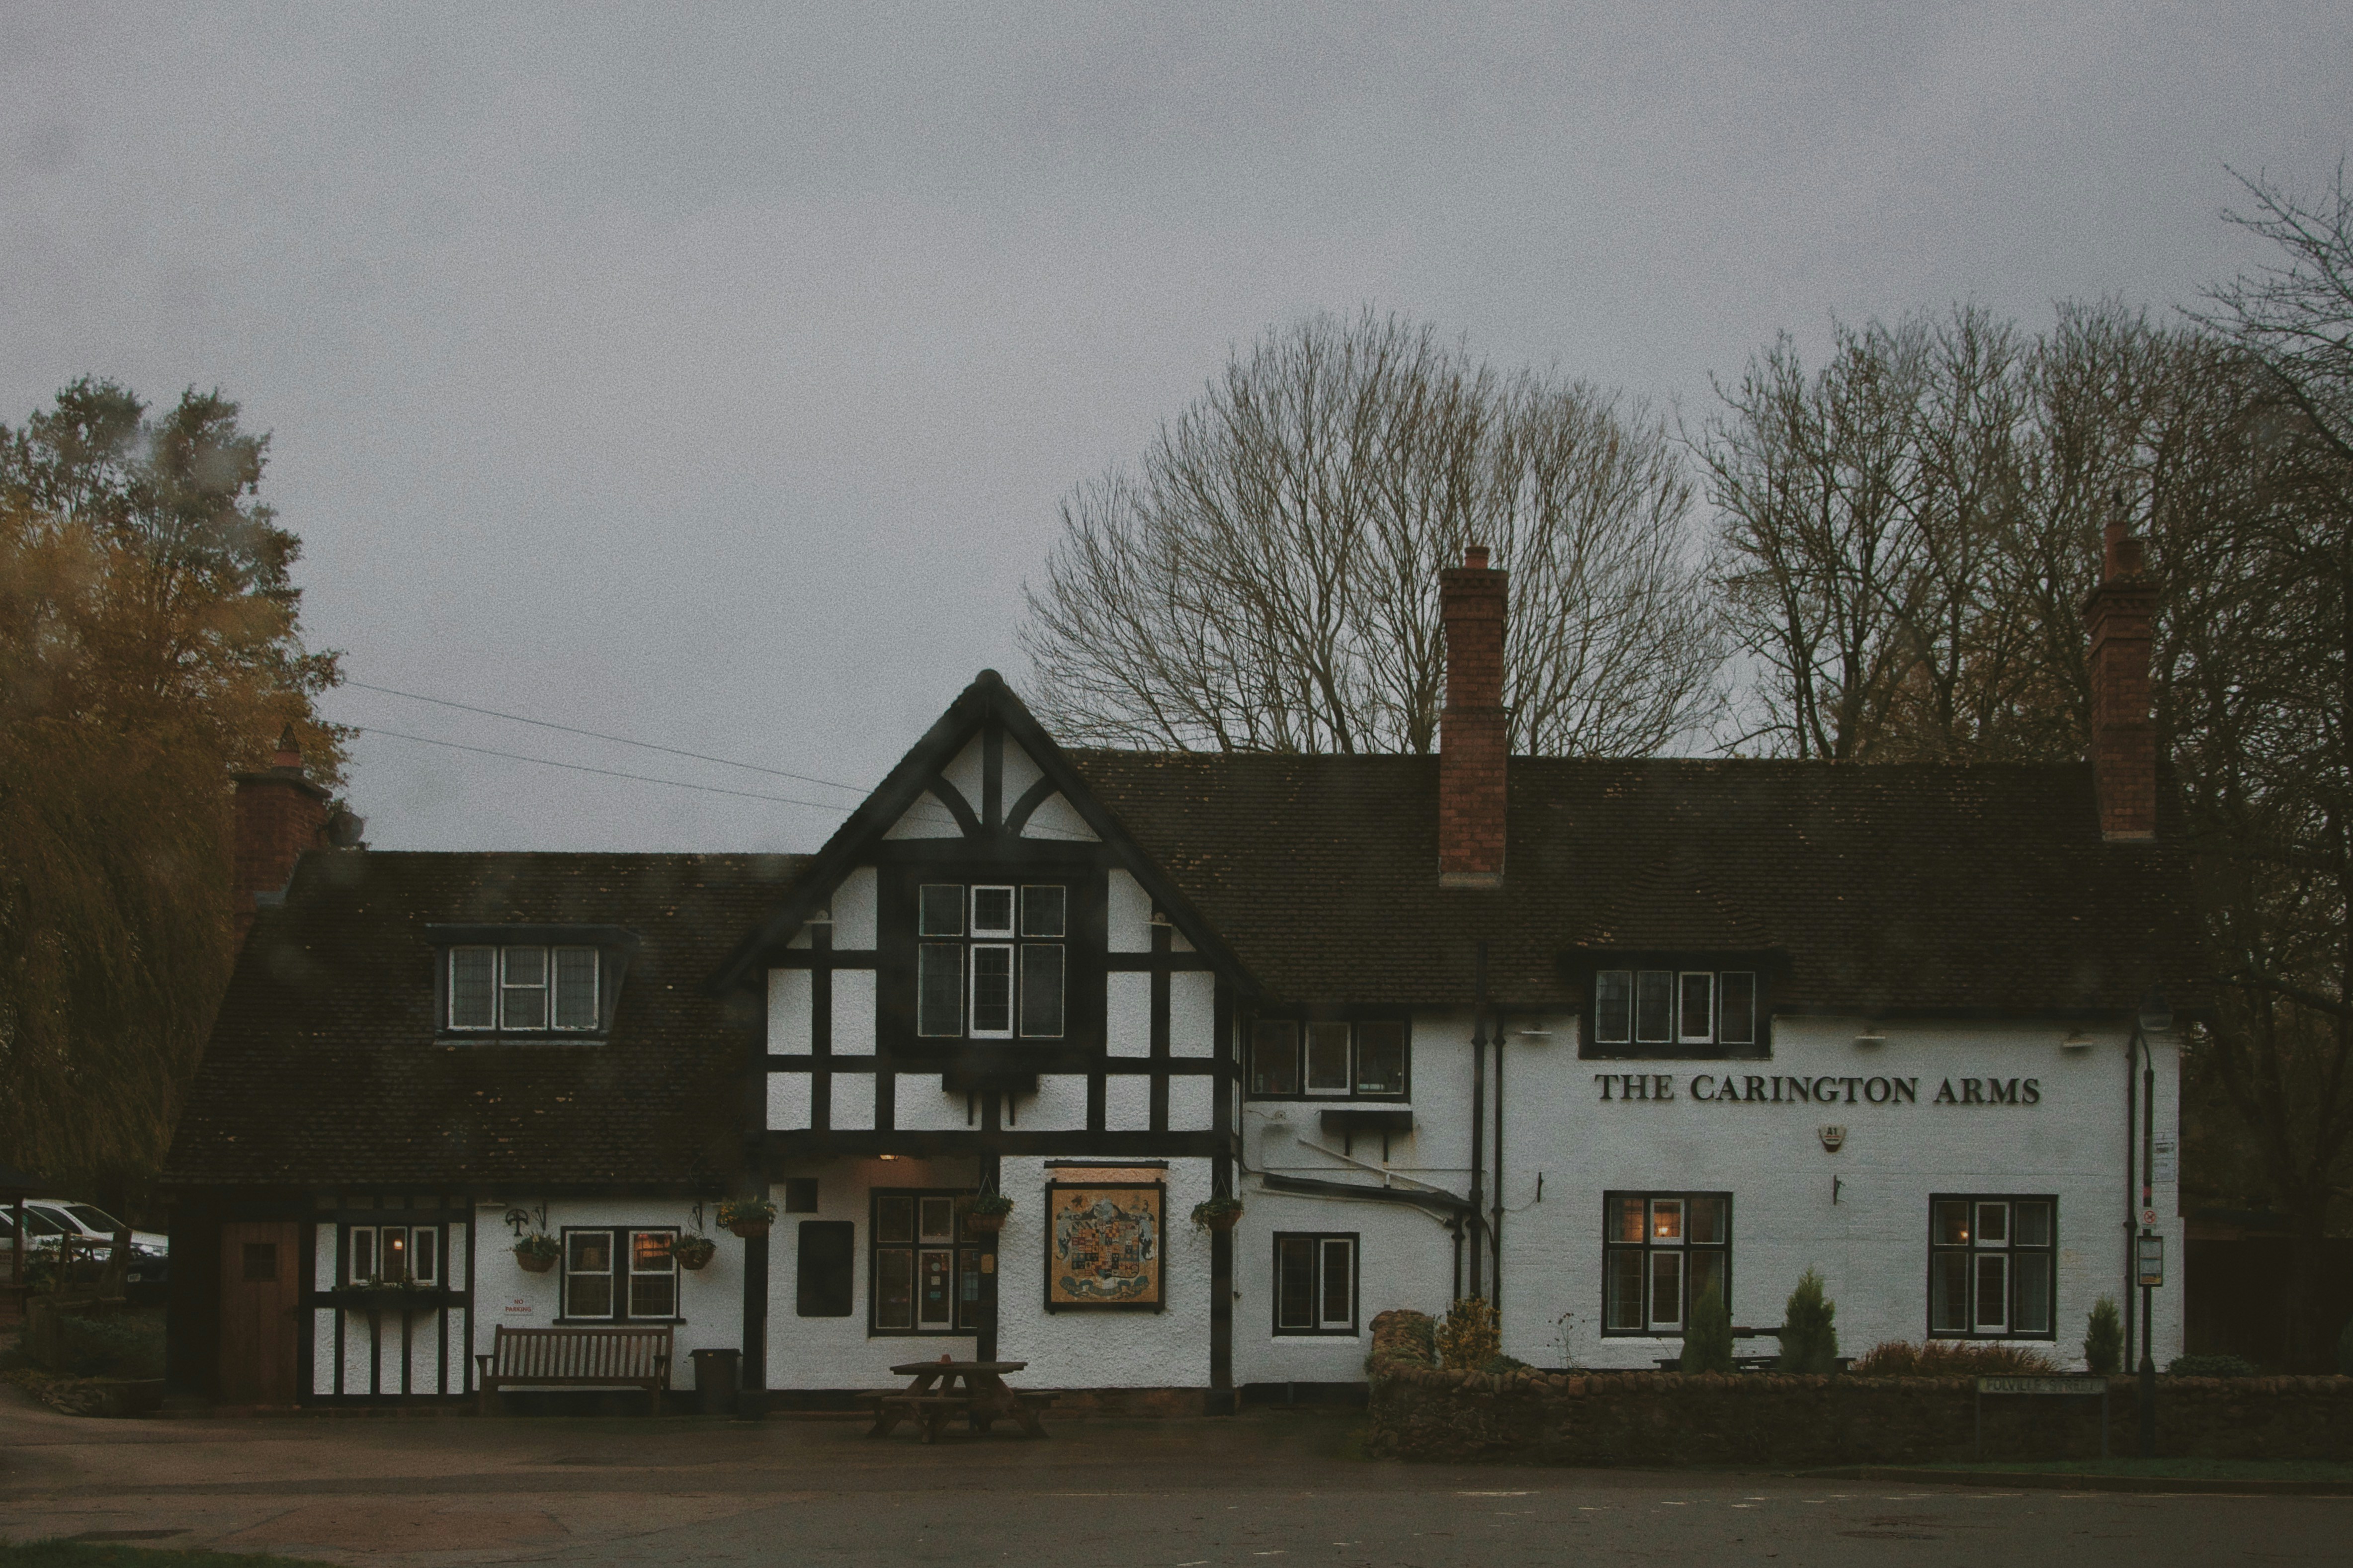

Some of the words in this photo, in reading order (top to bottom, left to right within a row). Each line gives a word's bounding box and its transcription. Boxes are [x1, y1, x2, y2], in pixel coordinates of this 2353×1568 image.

[1595, 1074, 1674, 1099] THE
[1691, 1074, 1919, 1103] CARINGTON
[1933, 1076, 2040, 1104] ARMS
